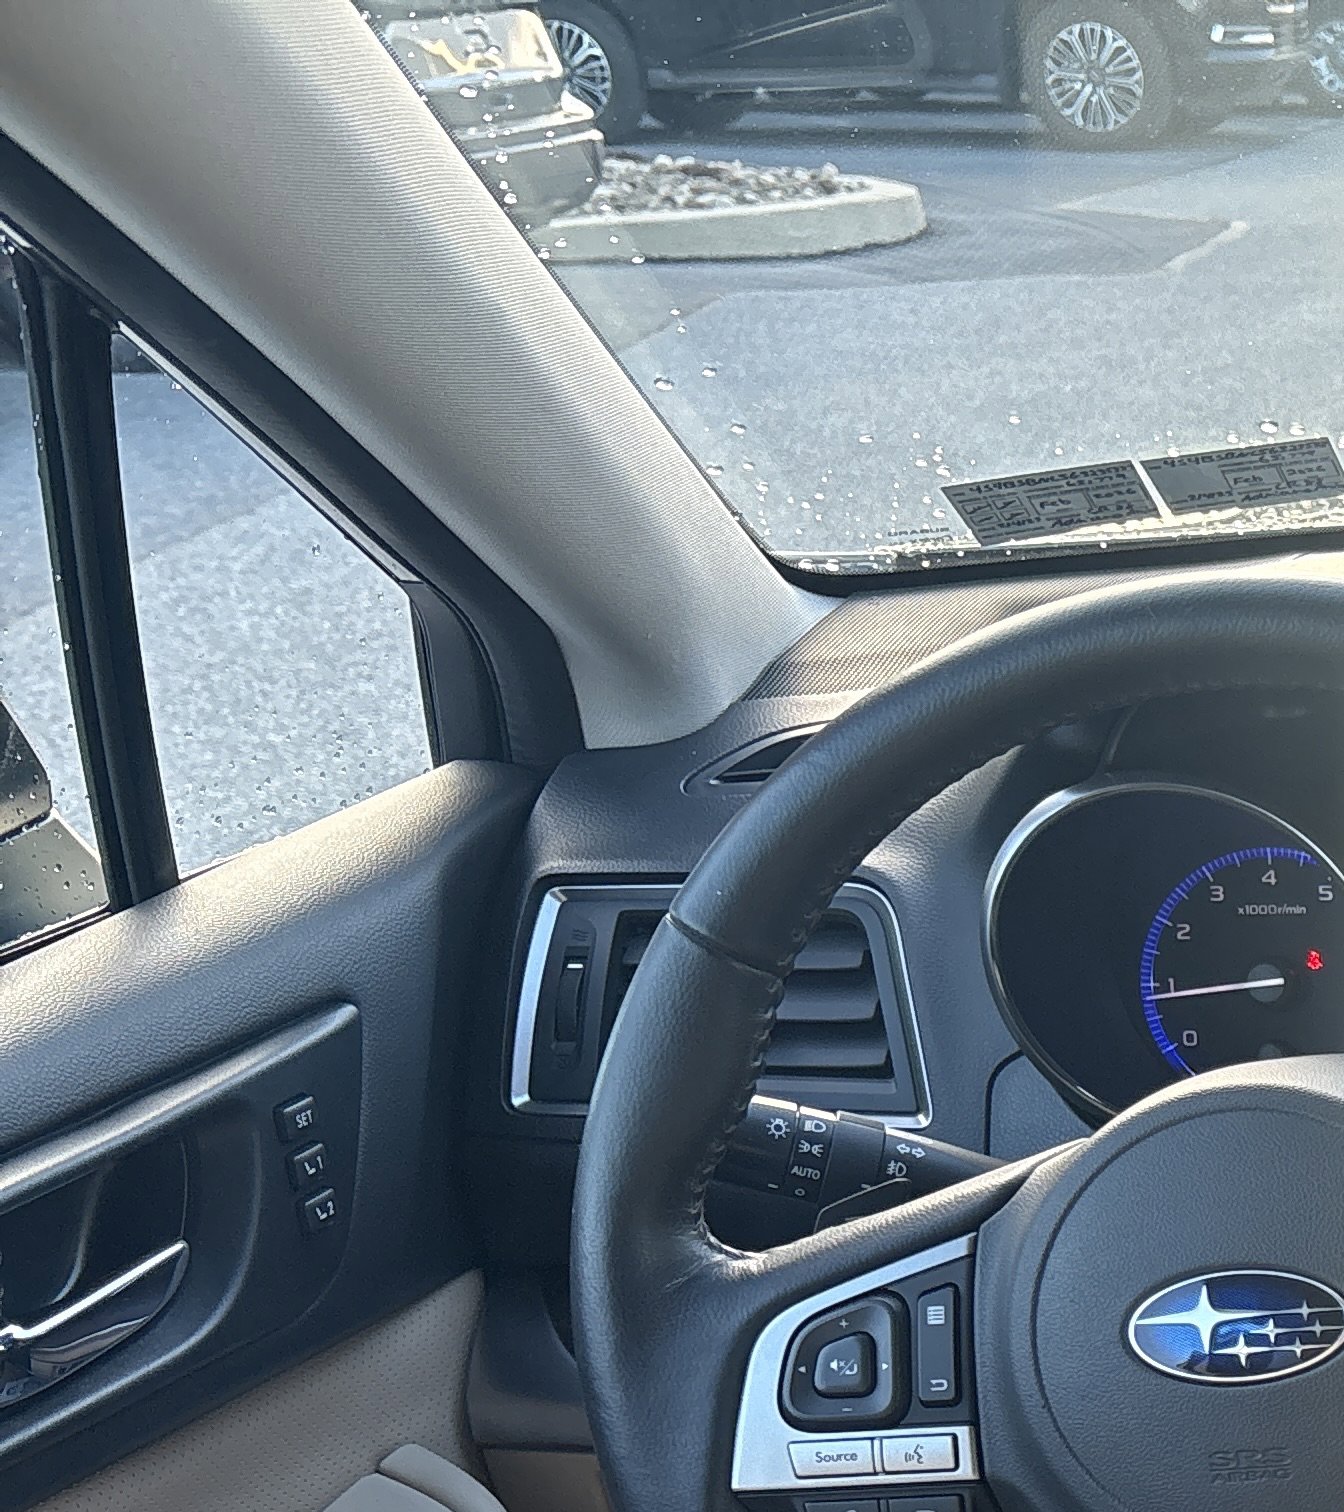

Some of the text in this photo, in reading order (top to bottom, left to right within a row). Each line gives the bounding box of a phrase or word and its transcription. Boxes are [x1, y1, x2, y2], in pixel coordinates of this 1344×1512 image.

[1261, 869, 1278, 886] 4
[1209, 885, 1225, 902] 3
[1318, 885, 1334, 902] 5
[1176, 923, 1191, 940] 2
[1167, 977, 1175, 993] 1
[1183, 1029, 1198, 1046] 0
[295, 1110, 314, 1129] SET
[790, 1164, 821, 1180] AUTO
[315, 1200, 335, 1221] L2
[815, 1451, 858, 1464] Source
